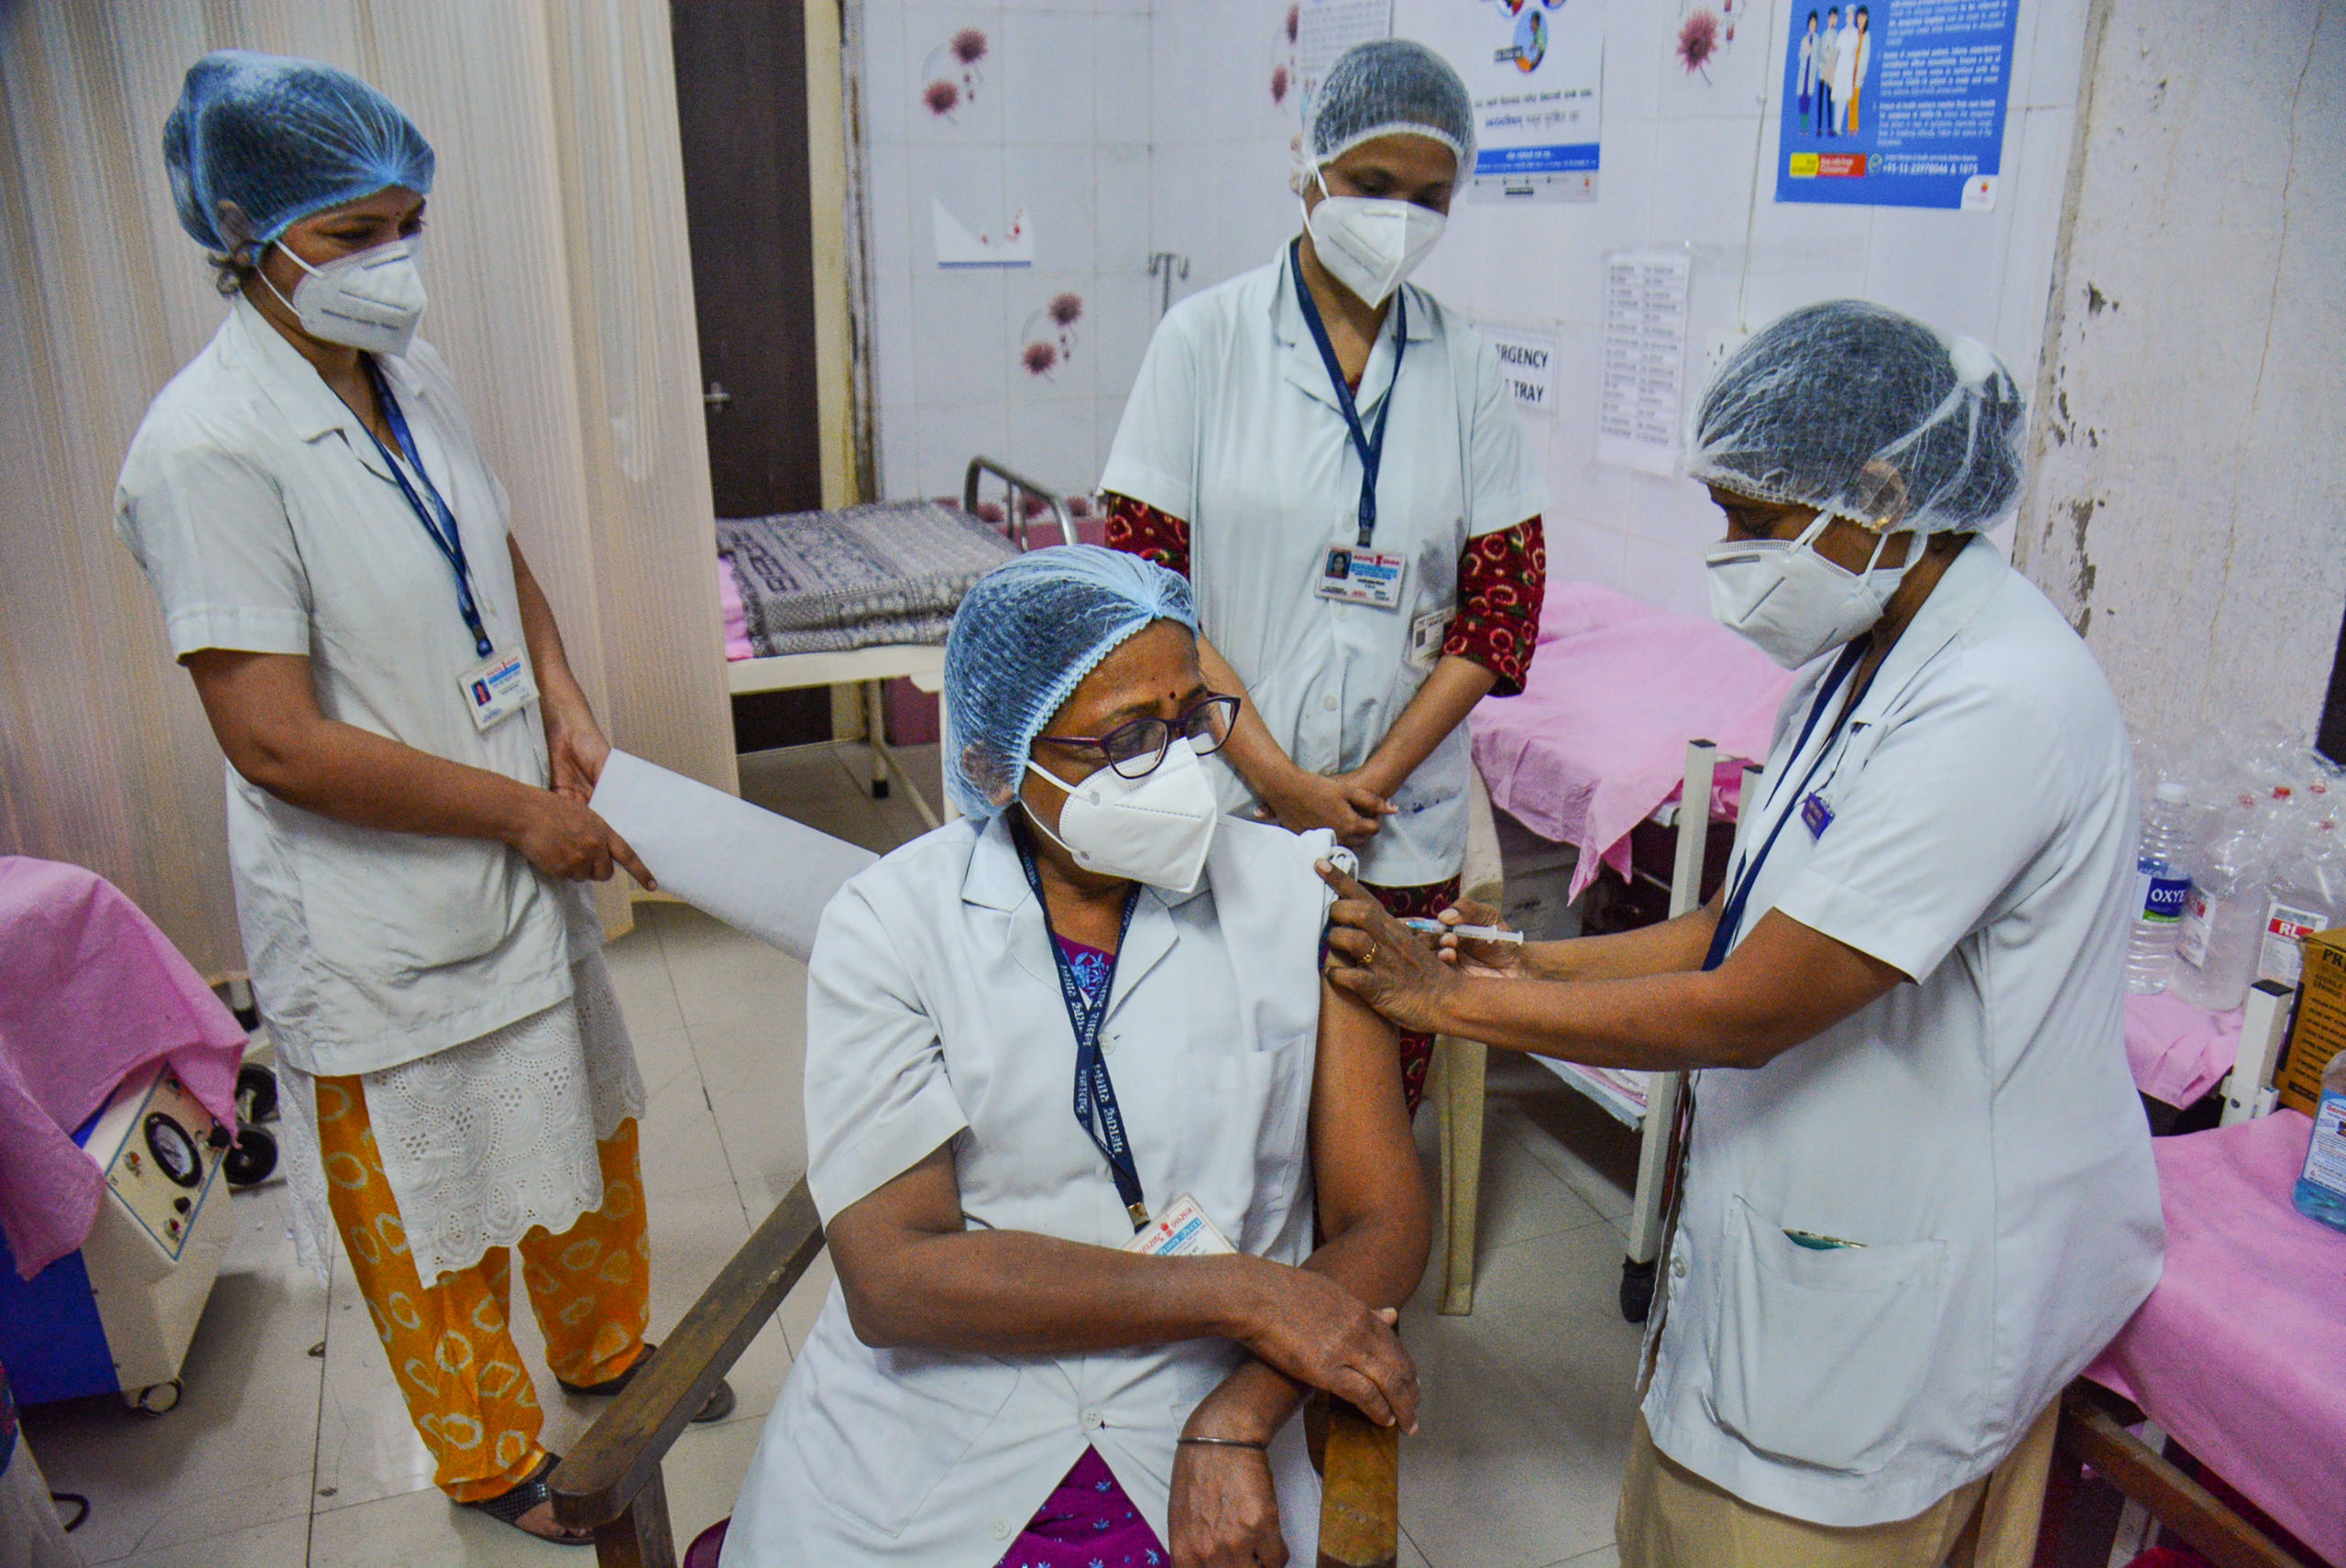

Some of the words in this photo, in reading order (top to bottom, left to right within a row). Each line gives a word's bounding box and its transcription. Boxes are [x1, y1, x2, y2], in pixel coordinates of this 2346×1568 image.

[1514, 379, 1545, 402] TRAY
[2278, 922, 2300, 938] RL
[2321, 948, 2346, 973] PR
[1102, 1106, 1124, 1154] महाराष्ट्र
